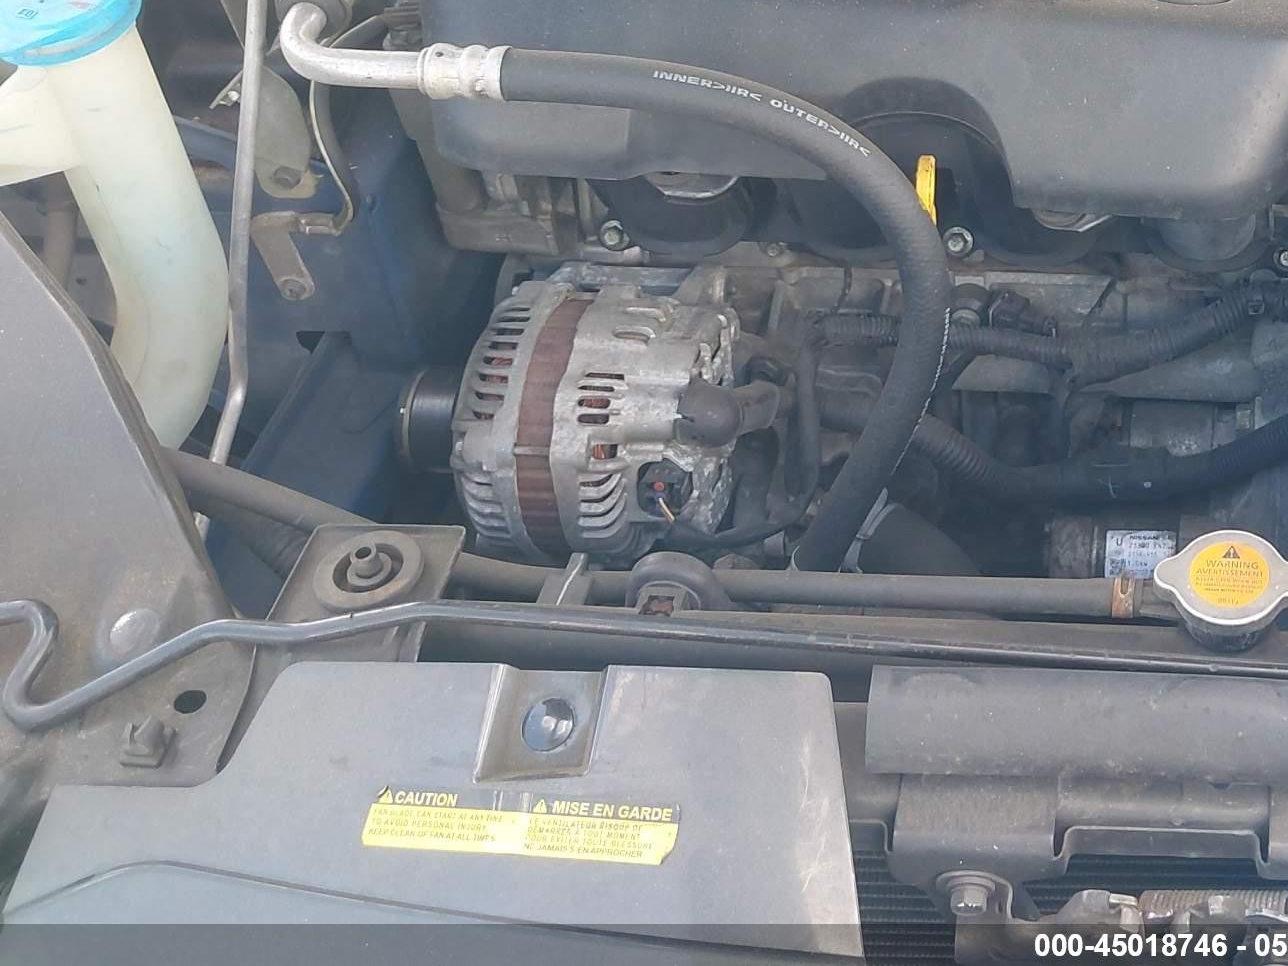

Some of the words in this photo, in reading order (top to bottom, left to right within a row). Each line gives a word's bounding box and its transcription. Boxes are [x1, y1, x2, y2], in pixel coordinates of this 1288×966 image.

[1206, 560, 1259, 570] WARNING
[394, 790, 459, 807] CAUTION
[552, 800, 590, 816] MISE
[592, 803, 616, 819] EN
[618, 805, 673, 822] GARDE
[383, 819, 410, 827] AVOID
[411, 820, 455, 830] PERSONAL
[457, 823, 487, 832] INJURY
[457, 833, 471, 841] ALL
[537, 844, 569, 852] JAMAIS
[591, 848, 643, 858] APPROCHER
